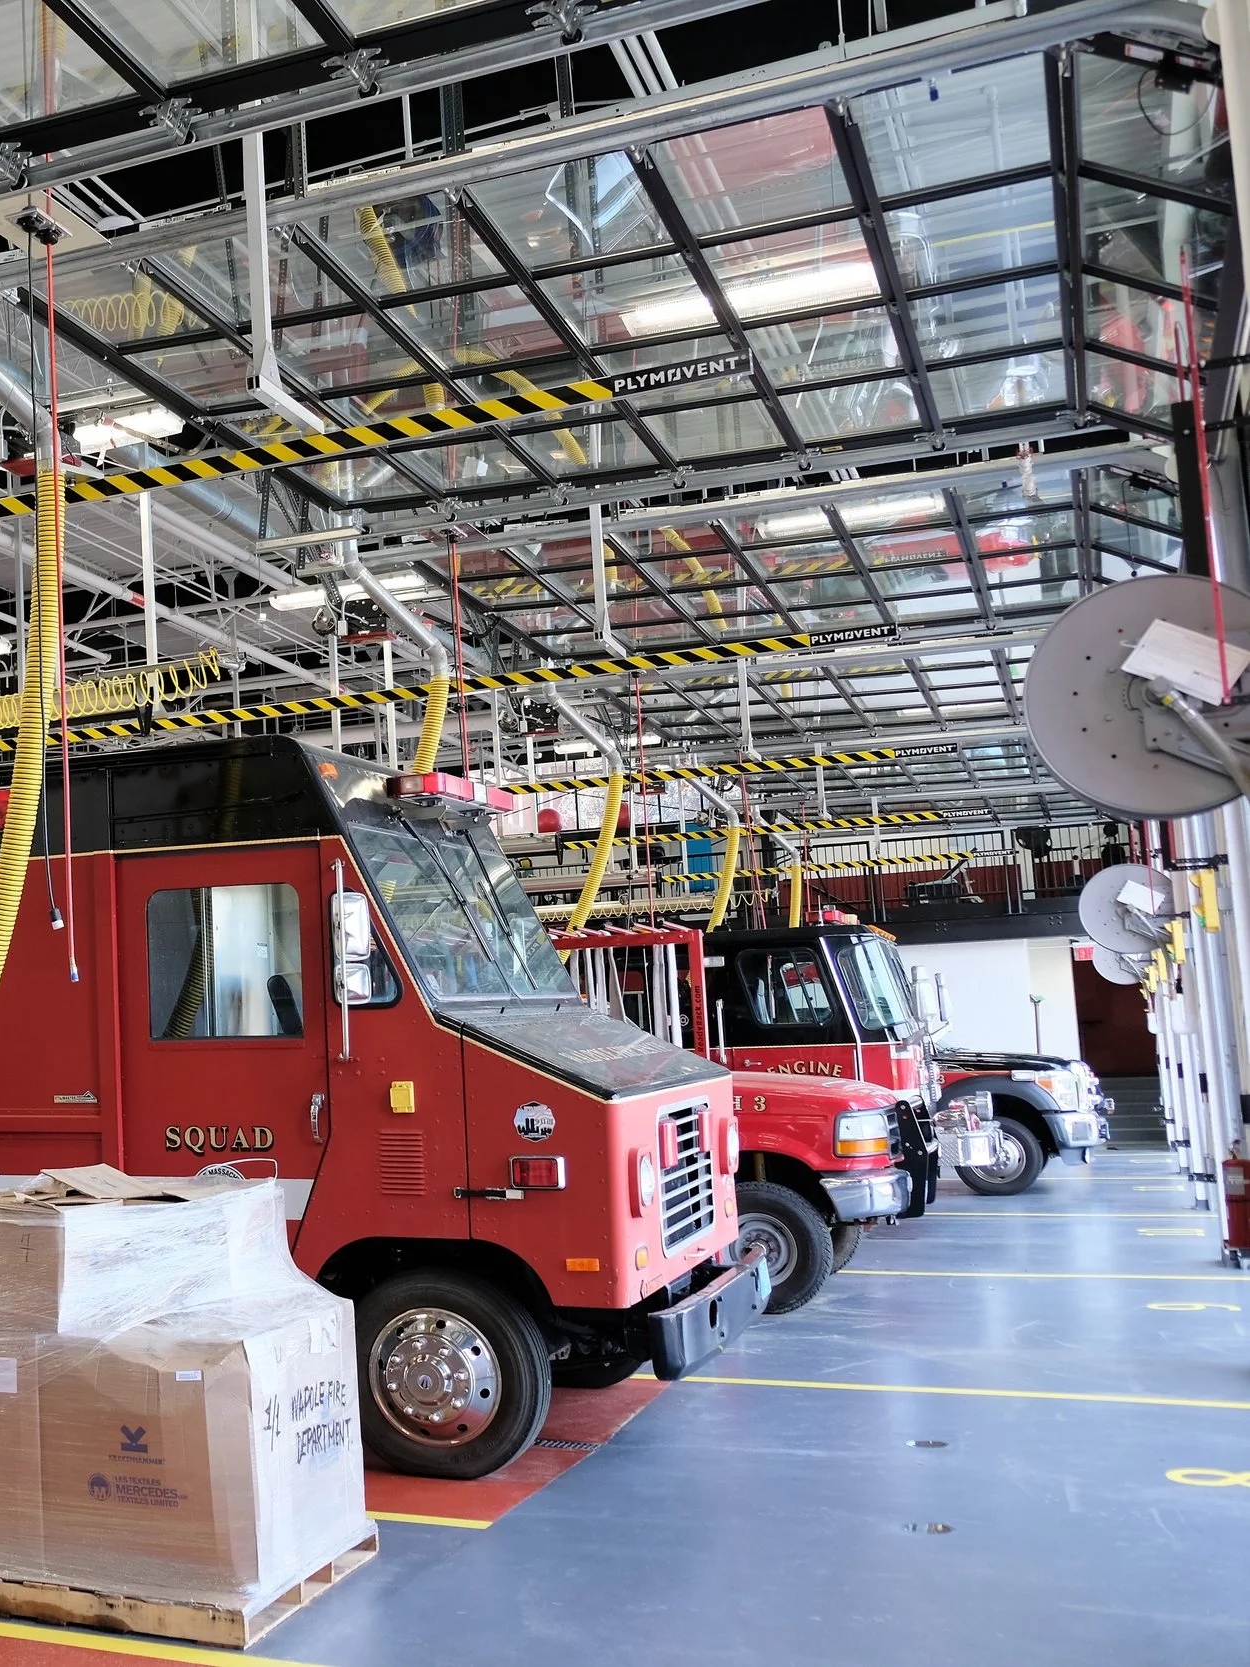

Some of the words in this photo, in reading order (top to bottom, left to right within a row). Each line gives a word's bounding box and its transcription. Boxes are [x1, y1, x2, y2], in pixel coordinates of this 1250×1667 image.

[614, 355, 741, 393] PLYMOVENT
[811, 626, 891, 645] PLYMOVENT
[895, 744, 954, 757] PLYMOVENT
[766, 1060, 843, 1077] ENGINE
[753, 1095, 766, 1112] 3
[165, 1126, 274, 1153] SQUAD
[327, 1379, 346, 1408] FIRE
[129, 1477, 161, 1487] TEXTILES
[116, 1484, 178, 1500] MERCEDES
[117, 1495, 149, 1506] TEXTILES
[150, 1499, 179, 1508] LIMITED
